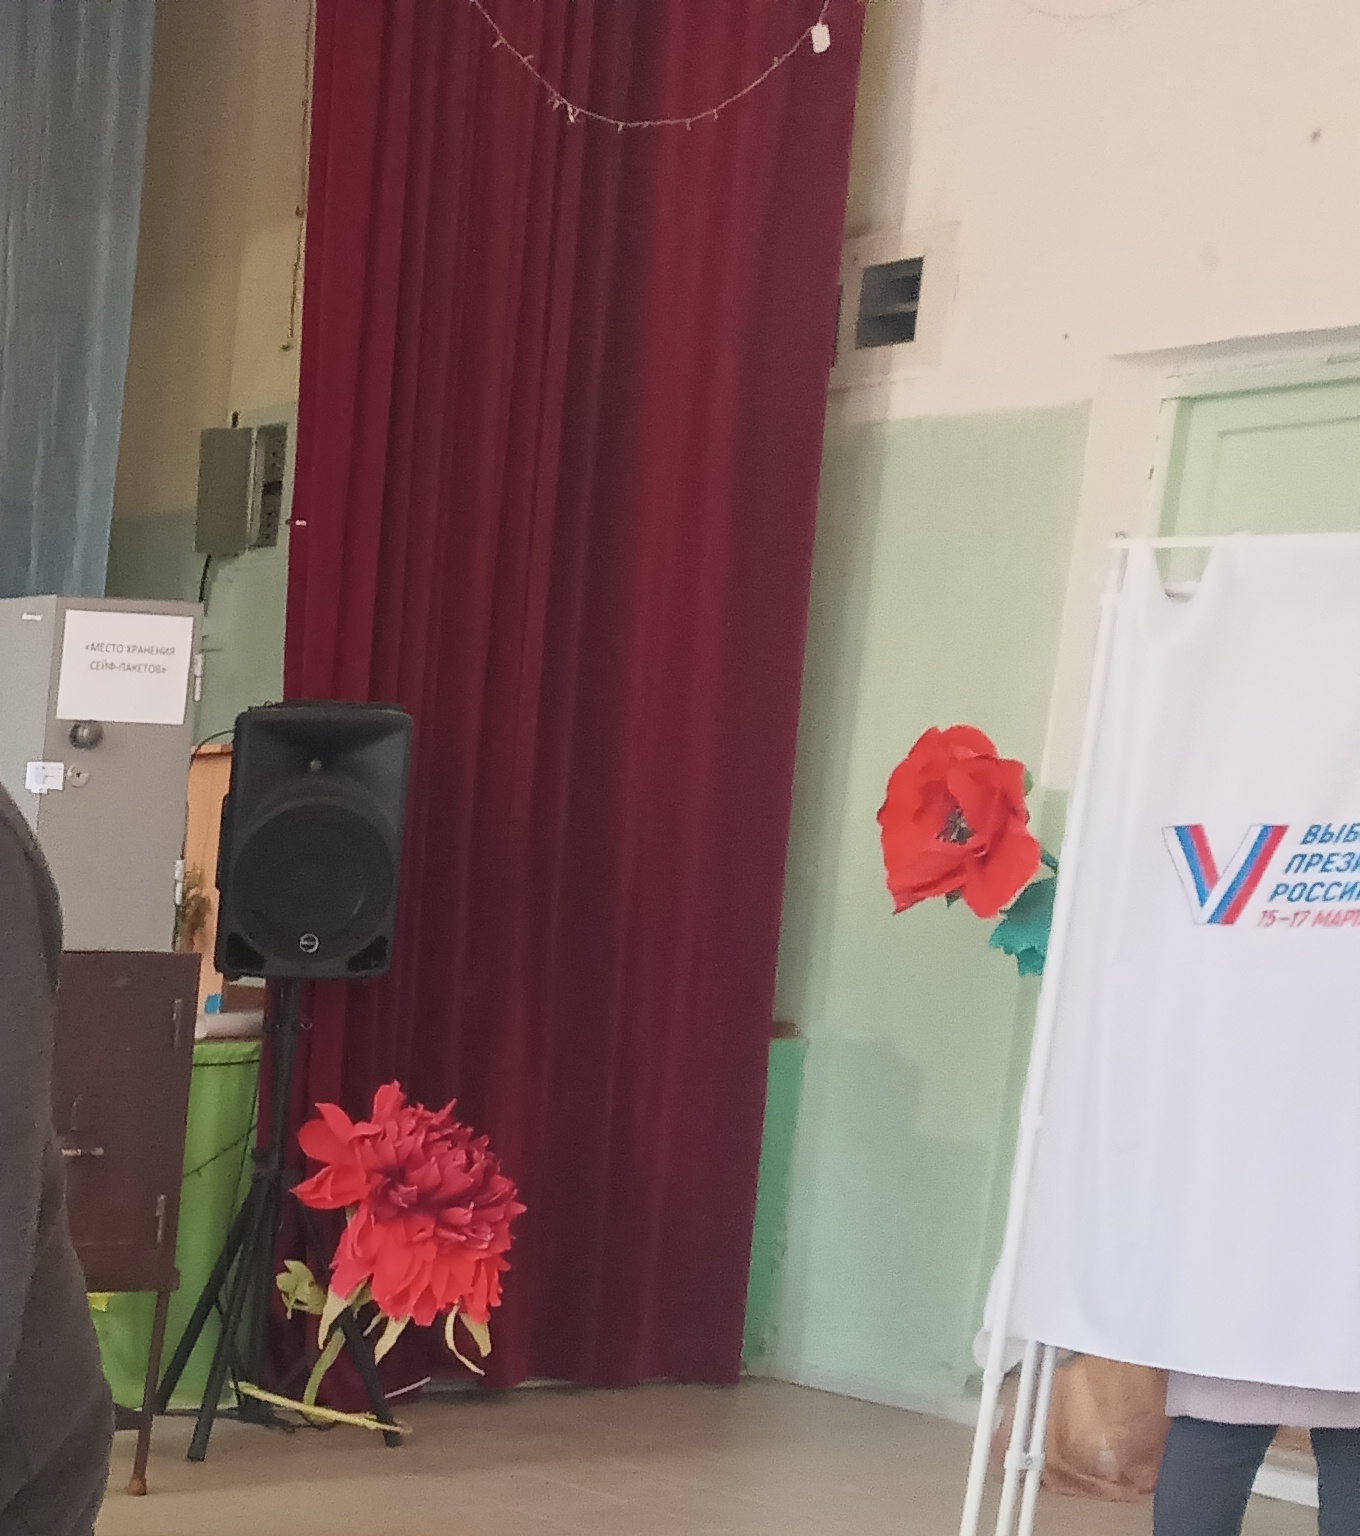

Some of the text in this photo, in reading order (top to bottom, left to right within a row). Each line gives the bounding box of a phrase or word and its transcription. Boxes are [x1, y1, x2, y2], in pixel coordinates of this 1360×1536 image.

[85, 642, 176, 656] «МЕСТО ХРАНЕНИЯ
[89, 659, 167, 674] СЕЙФ-ПАКЕТОВ»
[1267, 881, 1360, 903] РОССИ
